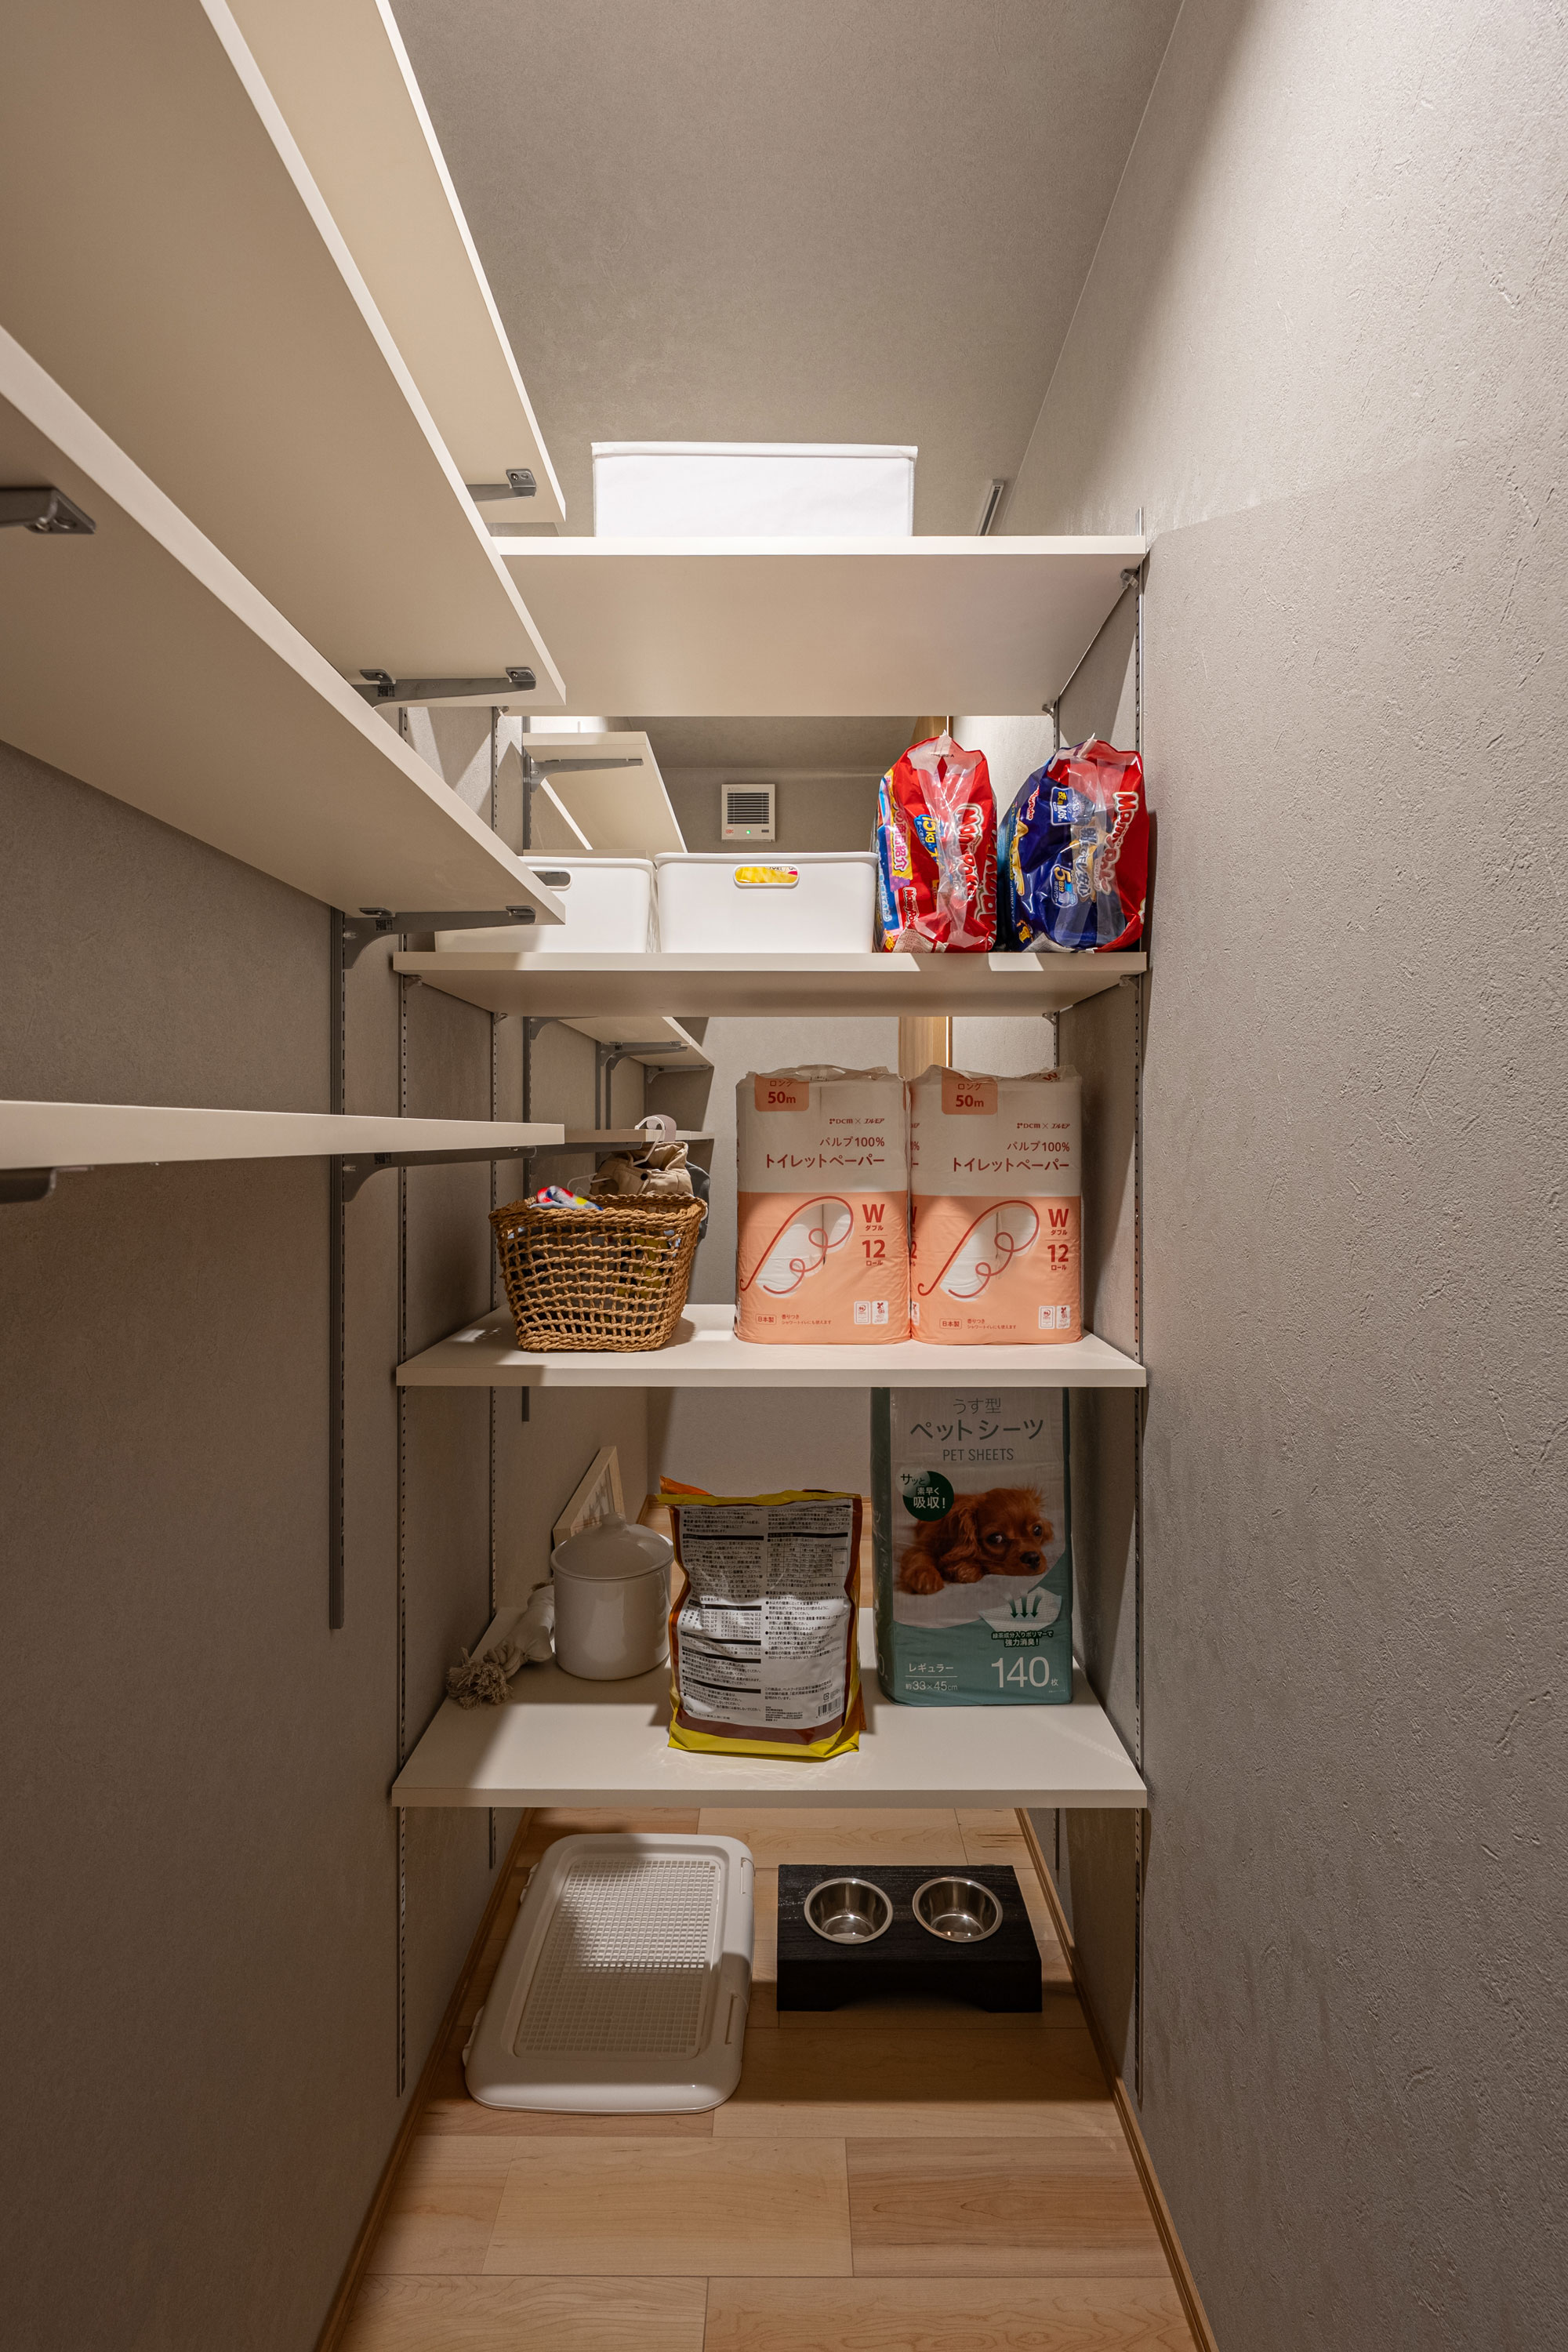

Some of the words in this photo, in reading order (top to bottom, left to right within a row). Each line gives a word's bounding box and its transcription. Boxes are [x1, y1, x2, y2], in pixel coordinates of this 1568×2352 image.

[906, 890, 916, 924] MamyPo
[768, 1091, 796, 1104] 50m
[956, 1095, 984, 1107] 50m
[819, 1137, 885, 1147] パルプ100%
[1007, 1142, 1070, 1152] パルプ100%
[766, 1153, 885, 1168] トイレットペーパー
[953, 1157, 1069, 1172] トイレットペーパー
[862, 1203, 885, 1223] W
[1047, 1208, 1069, 1228] W
[862, 1240, 886, 1258] 12
[1047, 1243, 1069, 1262] 12
[953, 1398, 1001, 1414] うす型
[910, 1419, 1044, 1441] ペットシーツ
[943, 1449, 964, 1461] PET
[968, 1448, 1014, 1461] SHEETS
[900, 1473, 927, 1486] サッと
[916, 1486, 940, 1495] 素早く
[992, 1631, 1053, 1639] 緑茶成分入りポリマーで
[909, 1663, 954, 1672] レギュラー
